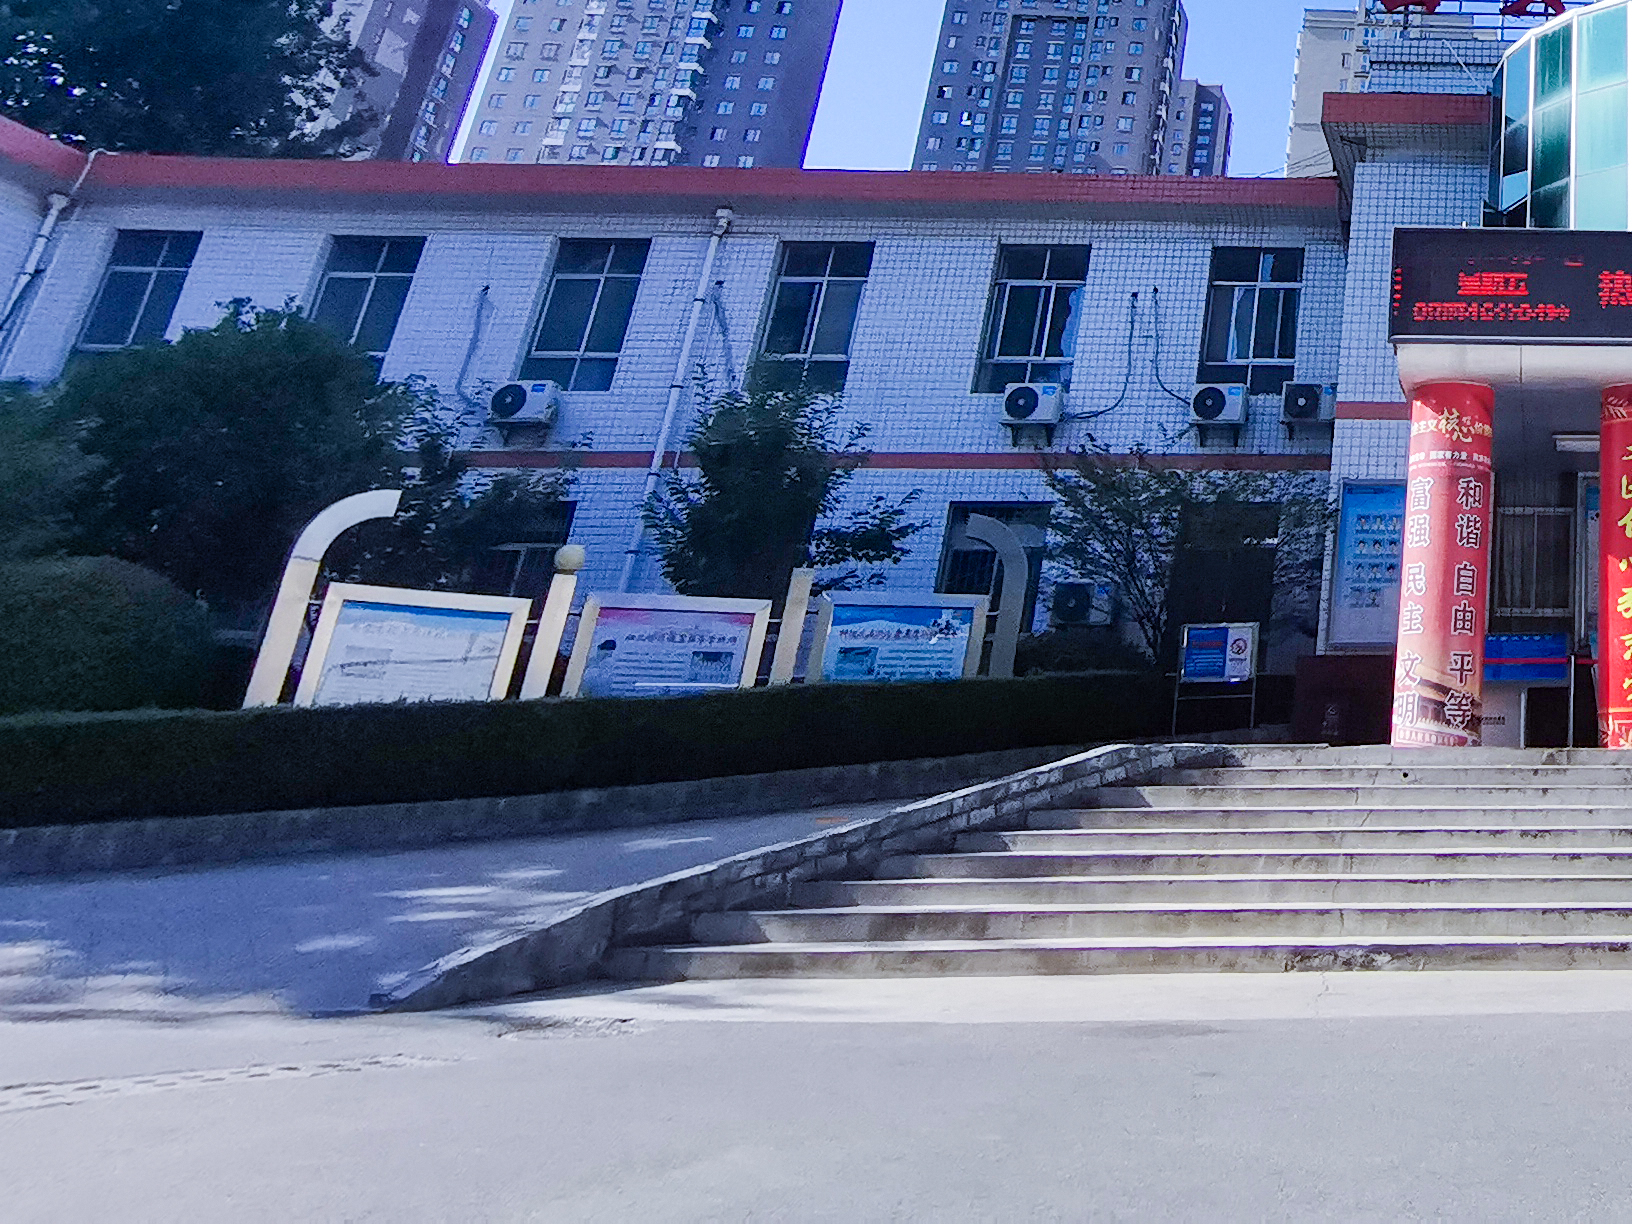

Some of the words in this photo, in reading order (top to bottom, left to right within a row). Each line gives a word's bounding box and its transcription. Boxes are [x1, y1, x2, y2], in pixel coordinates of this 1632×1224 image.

[1407, 477, 1434, 548] 富强
[1455, 477, 1483, 549] 和谐
[1401, 562, 1427, 635] 民主
[1451, 561, 1478, 636] 自由
[1396, 651, 1422, 728] 文明
[1443, 651, 1475, 730] 平等
